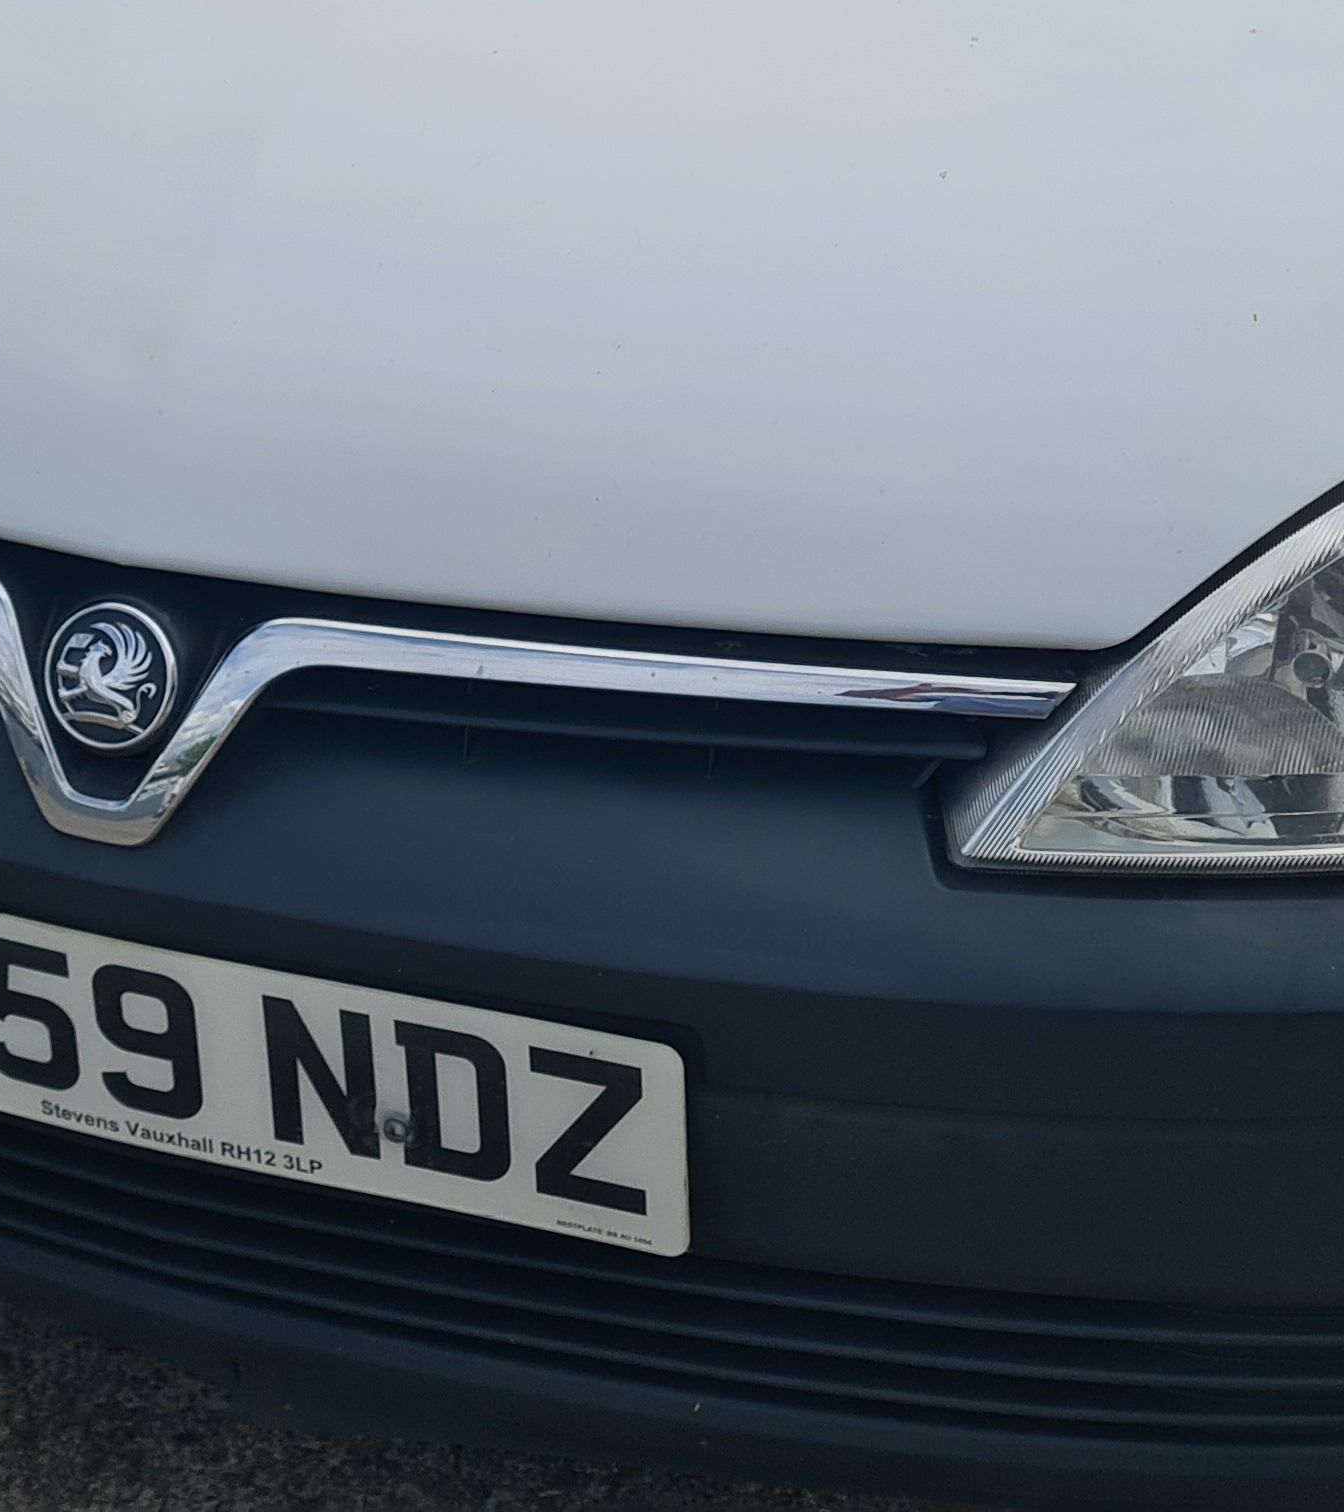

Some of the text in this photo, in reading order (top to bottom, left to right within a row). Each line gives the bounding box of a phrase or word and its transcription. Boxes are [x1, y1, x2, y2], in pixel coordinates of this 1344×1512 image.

[40, 1099, 324, 1175] Stevens Vauxhall RH12 3LP
[260, 993, 648, 1217] NDZ
